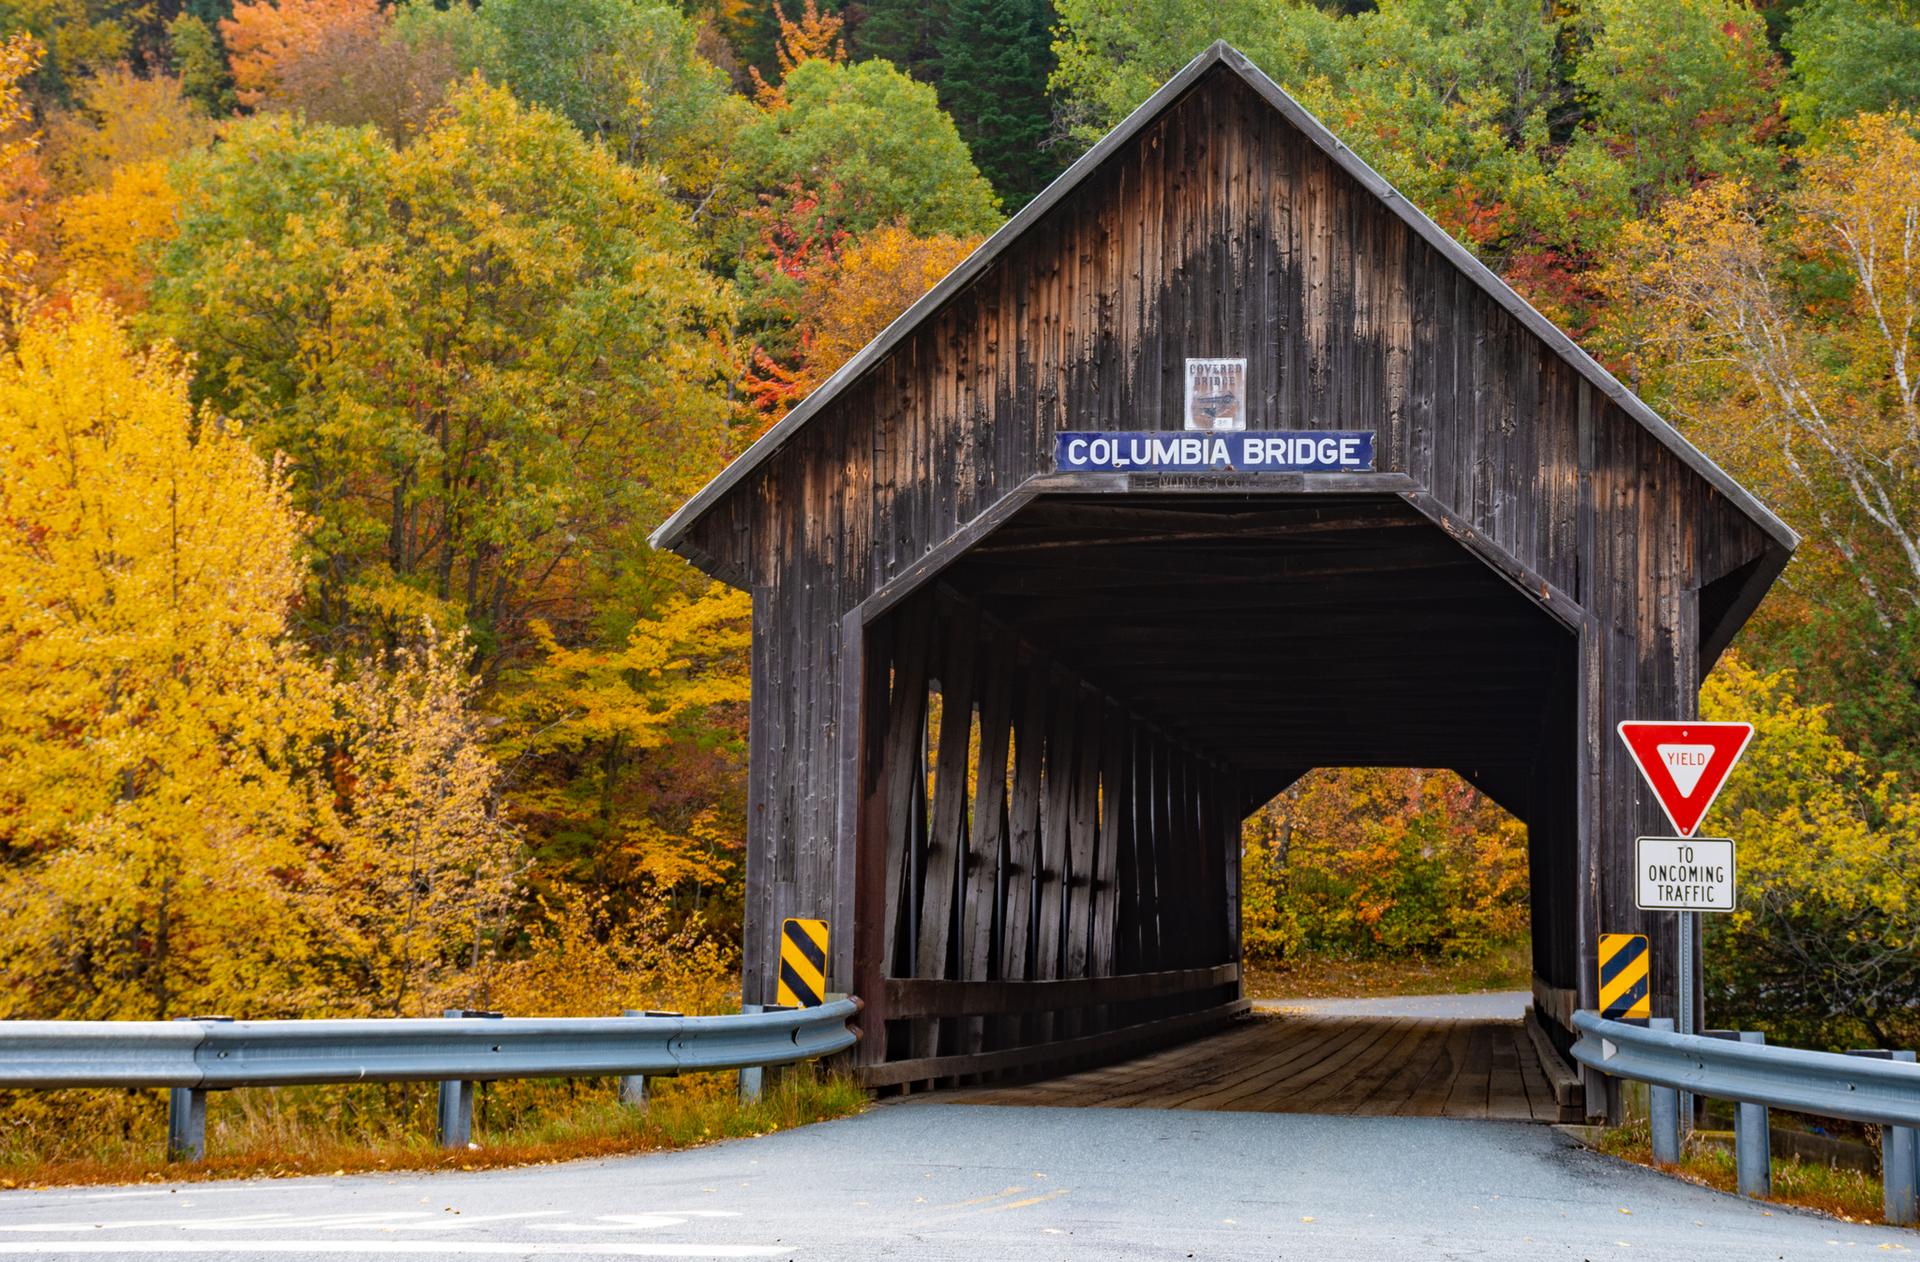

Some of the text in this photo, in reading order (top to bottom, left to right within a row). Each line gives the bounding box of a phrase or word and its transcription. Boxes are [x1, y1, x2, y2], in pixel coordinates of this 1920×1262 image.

[1189, 363, 1242, 375] COVERED
[1194, 376, 1236, 386] BRIDGE
[1068, 438, 1361, 465] COLUMBIA BRIDGE
[1667, 752, 1705, 766] YIELD
[1677, 846, 1694, 864] TO
[1649, 865, 1724, 883] ONCOMING
[1657, 884, 1715, 902] TRAFFIC
